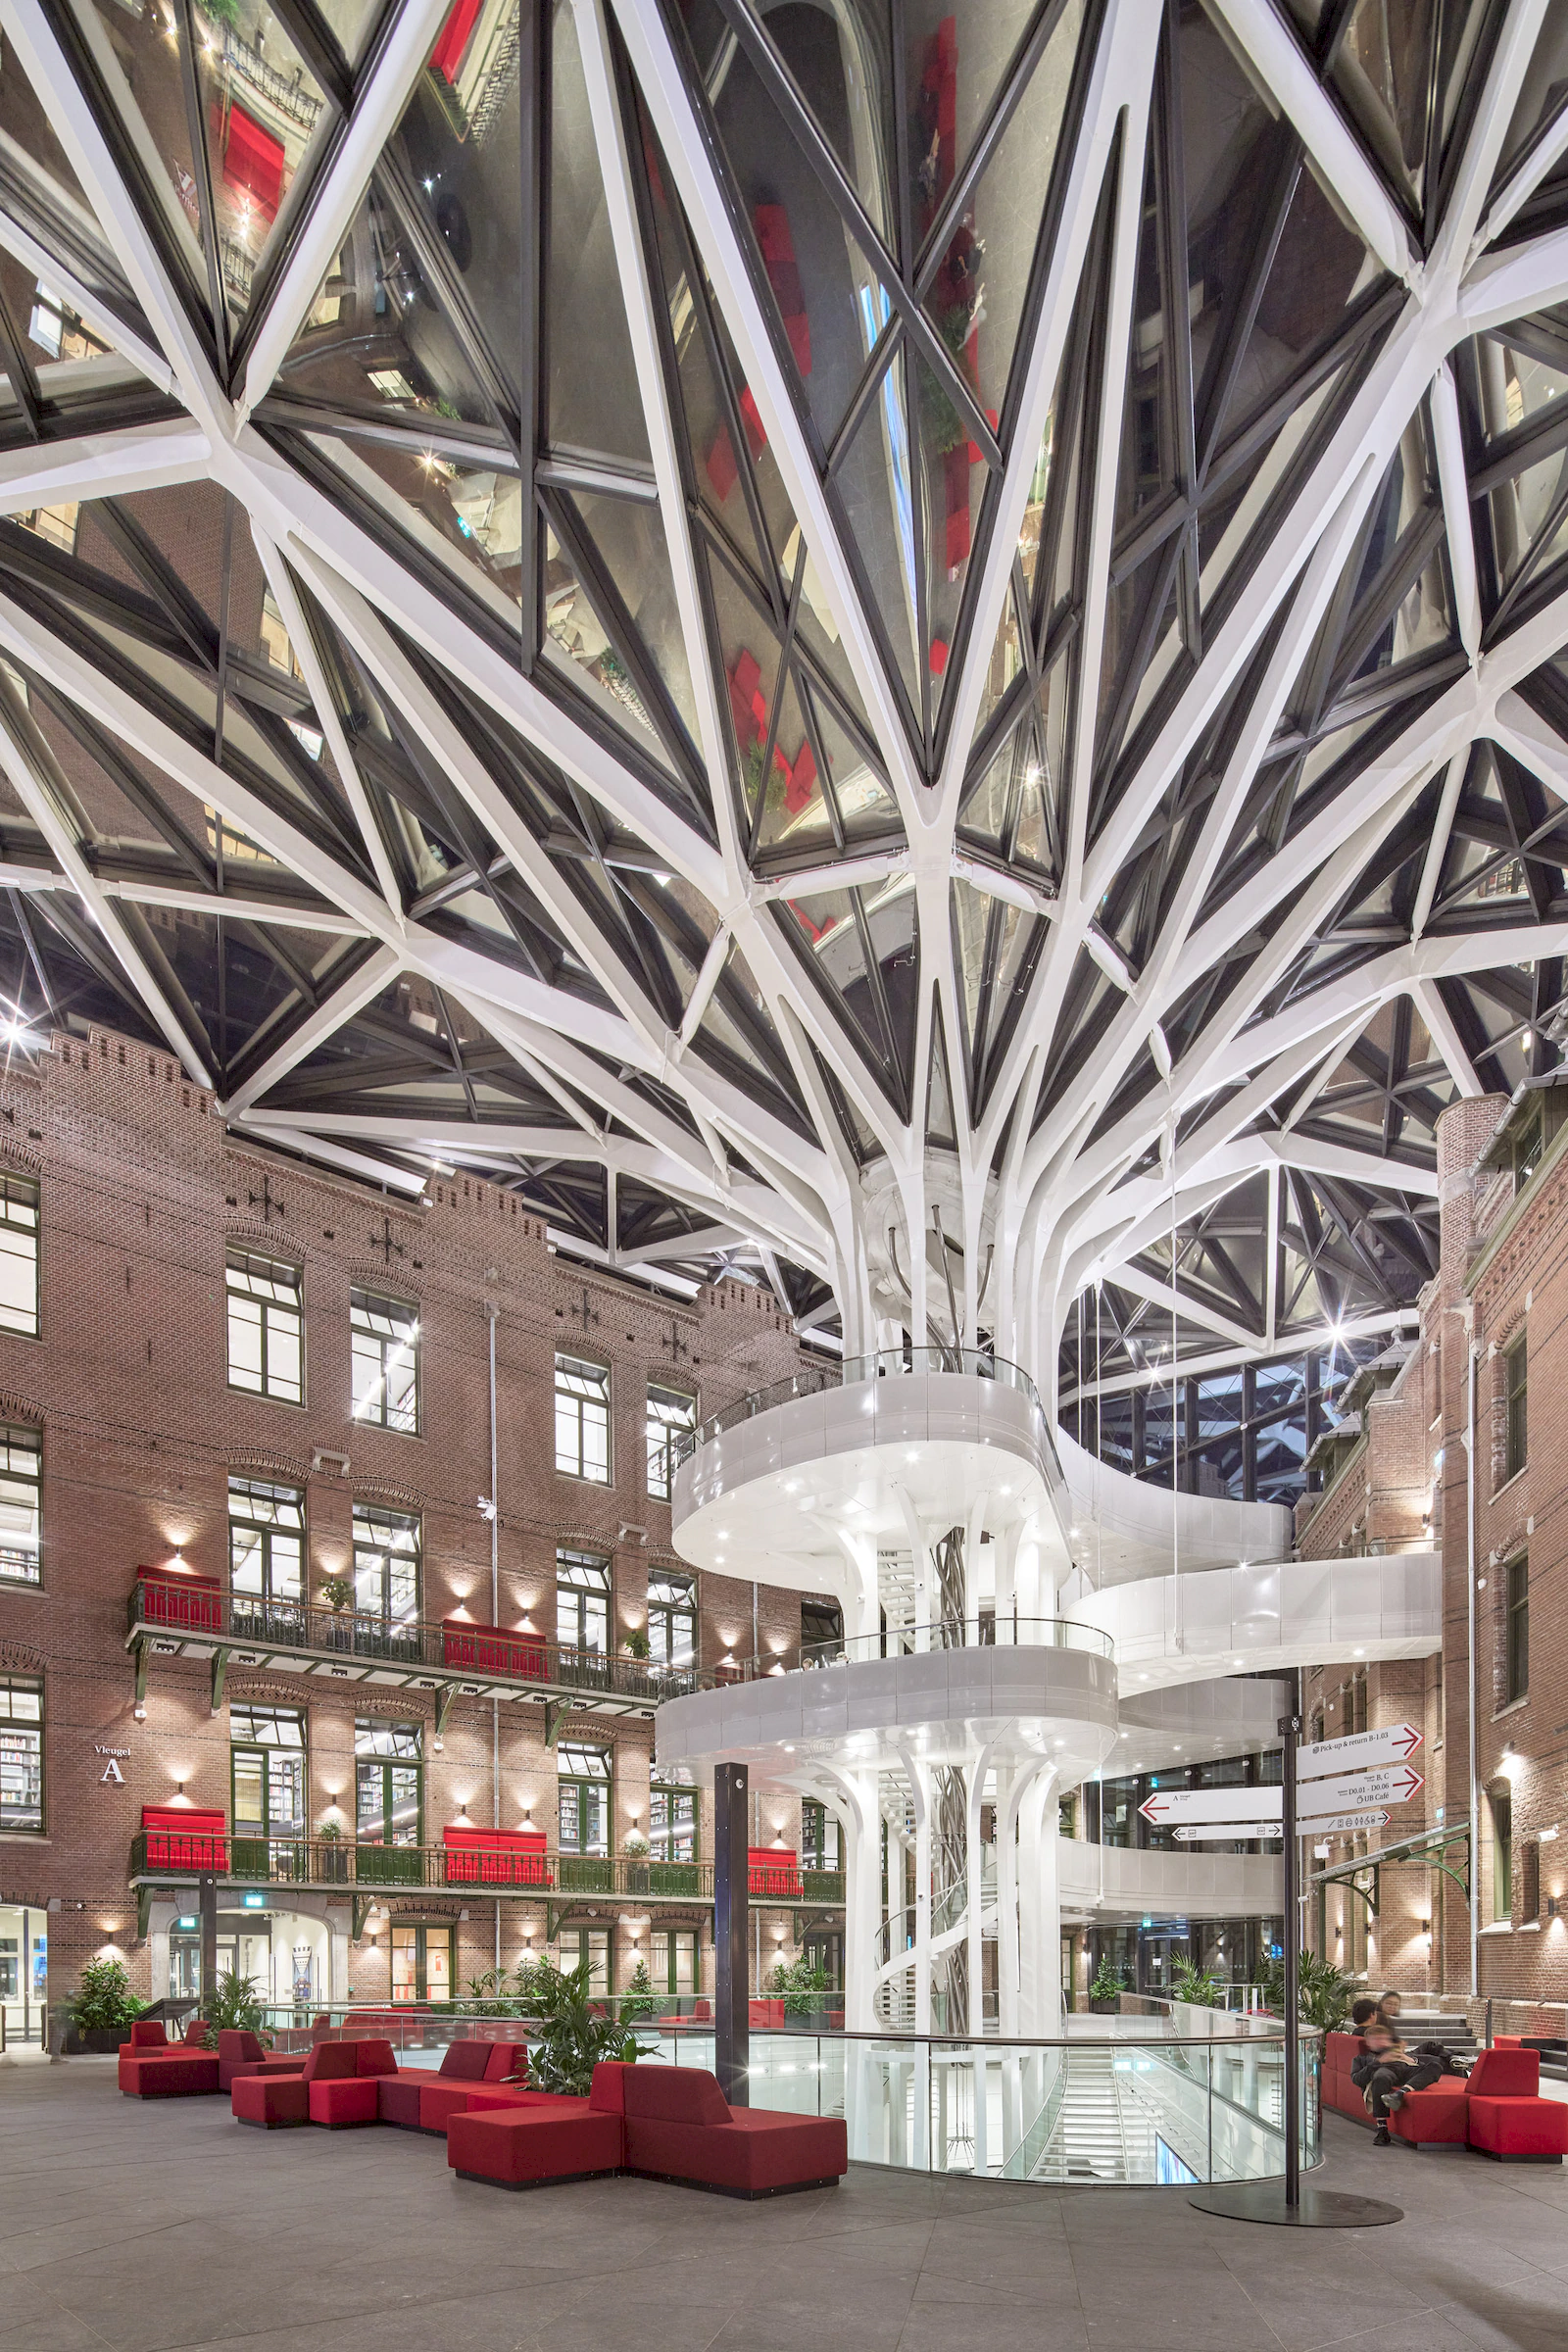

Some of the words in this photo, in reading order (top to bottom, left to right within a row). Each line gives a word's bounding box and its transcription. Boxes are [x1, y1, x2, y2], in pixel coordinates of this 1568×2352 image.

[1320, 1743, 1342, 1752] Pick-up
[1348, 1738, 1367, 1746] return
[1369, 1732, 1389, 1741] B-1.03
[94, 1745, 130, 1757] Vleugel
[100, 1758, 126, 1783] A
[1348, 1787, 1365, 1795] D0.01
[1372, 1783, 1389, 1791] D0.06
[1375, 1791, 1389, 1800] Café
